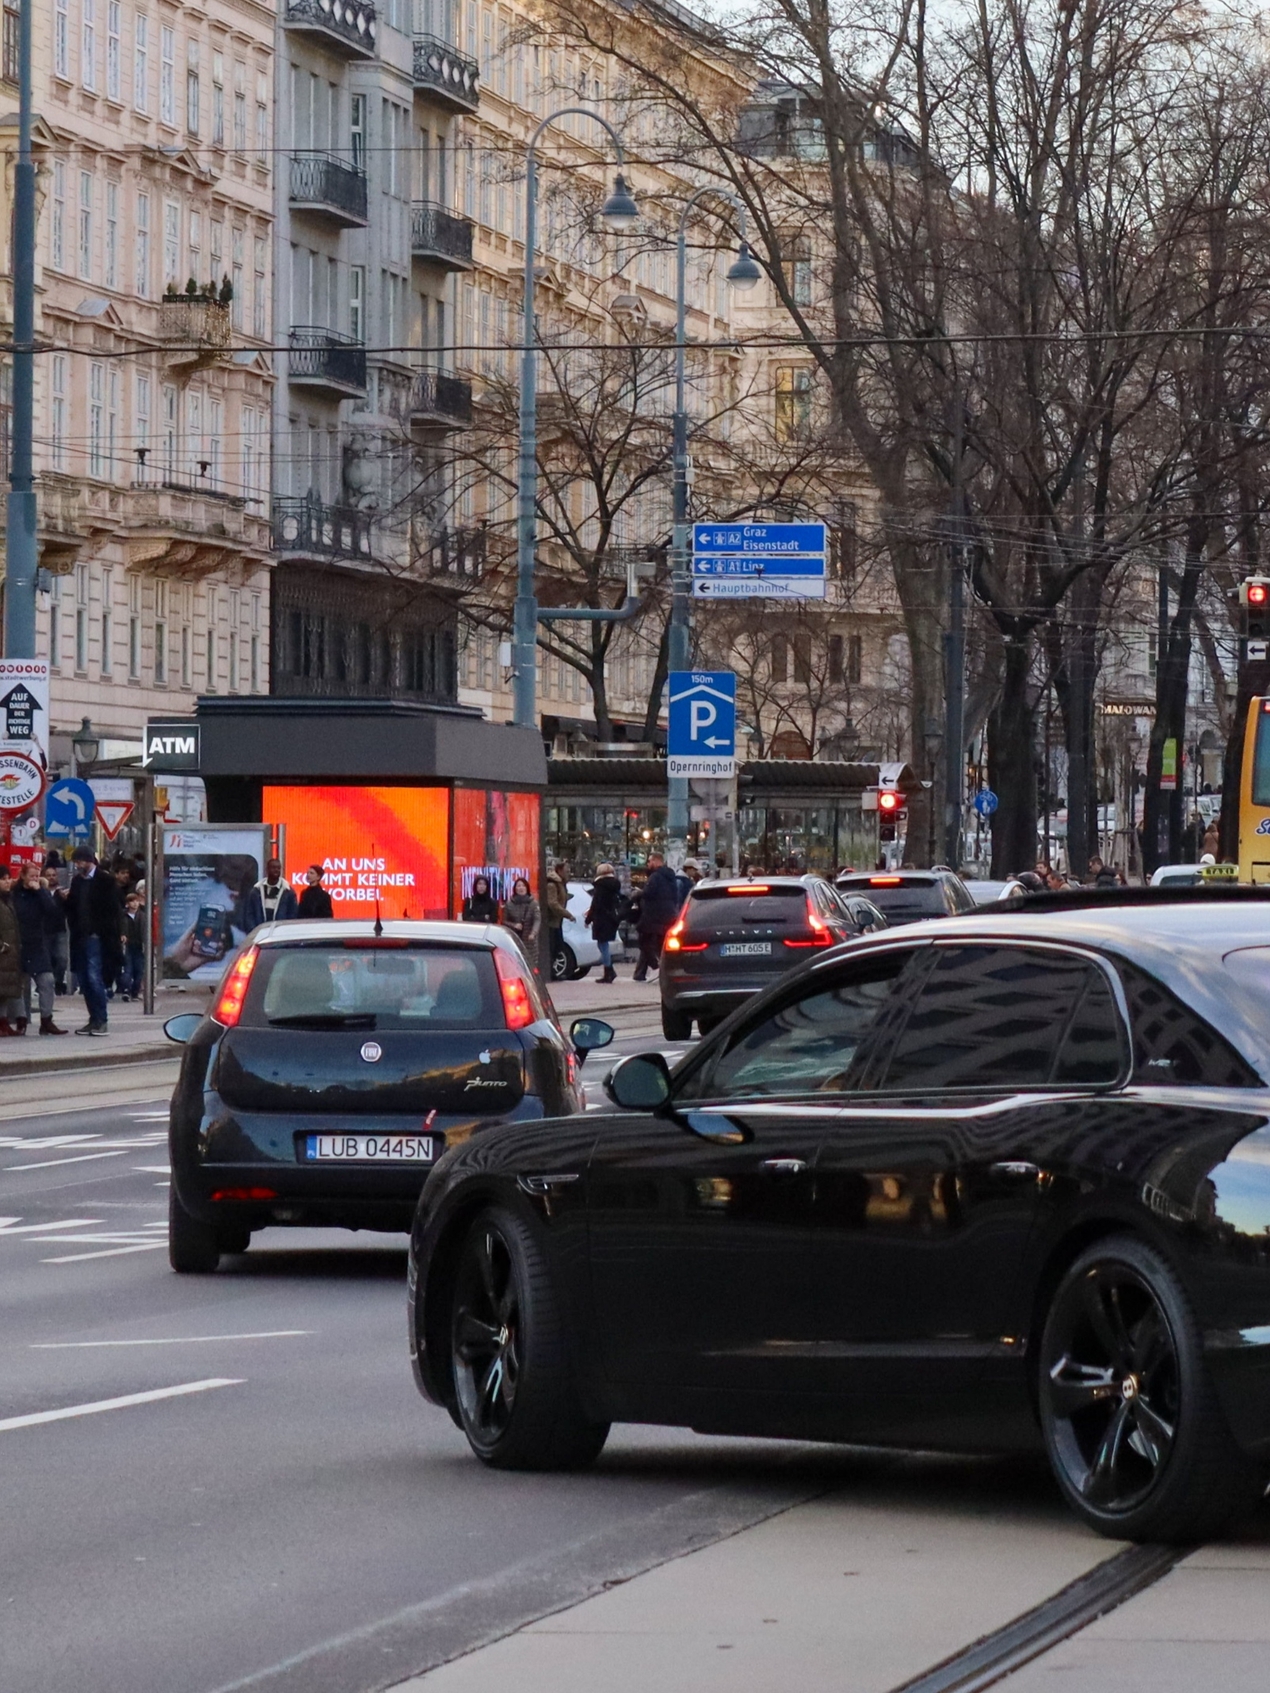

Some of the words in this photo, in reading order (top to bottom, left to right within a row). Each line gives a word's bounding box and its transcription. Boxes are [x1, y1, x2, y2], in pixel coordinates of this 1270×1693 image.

[743, 526, 767, 537] Graz
[728, 533, 740, 544] A2
[743, 540, 799, 551] Eisenstadt
[728, 561, 740, 571] A1
[742, 561, 765, 572] Linz
[712, 583, 789, 595] Hauptbahnhof
[691, 674, 713, 684] 150m
[11, 692, 29, 701] AUF
[690, 700, 717, 741] P
[9, 725, 29, 735] WEG
[148, 736, 195, 754] ATM
[670, 760, 732, 775] Opernringhof
[0, 788, 35, 805] ESTELLE
[322, 858, 347, 870] AN
[352, 858, 385, 871] UNS
[358, 873, 415, 887] KEINER
[461, 866, 501, 900] INFTY
[318, 1137, 359, 1158] LUB
[365, 1137, 431, 1159] 0445N
